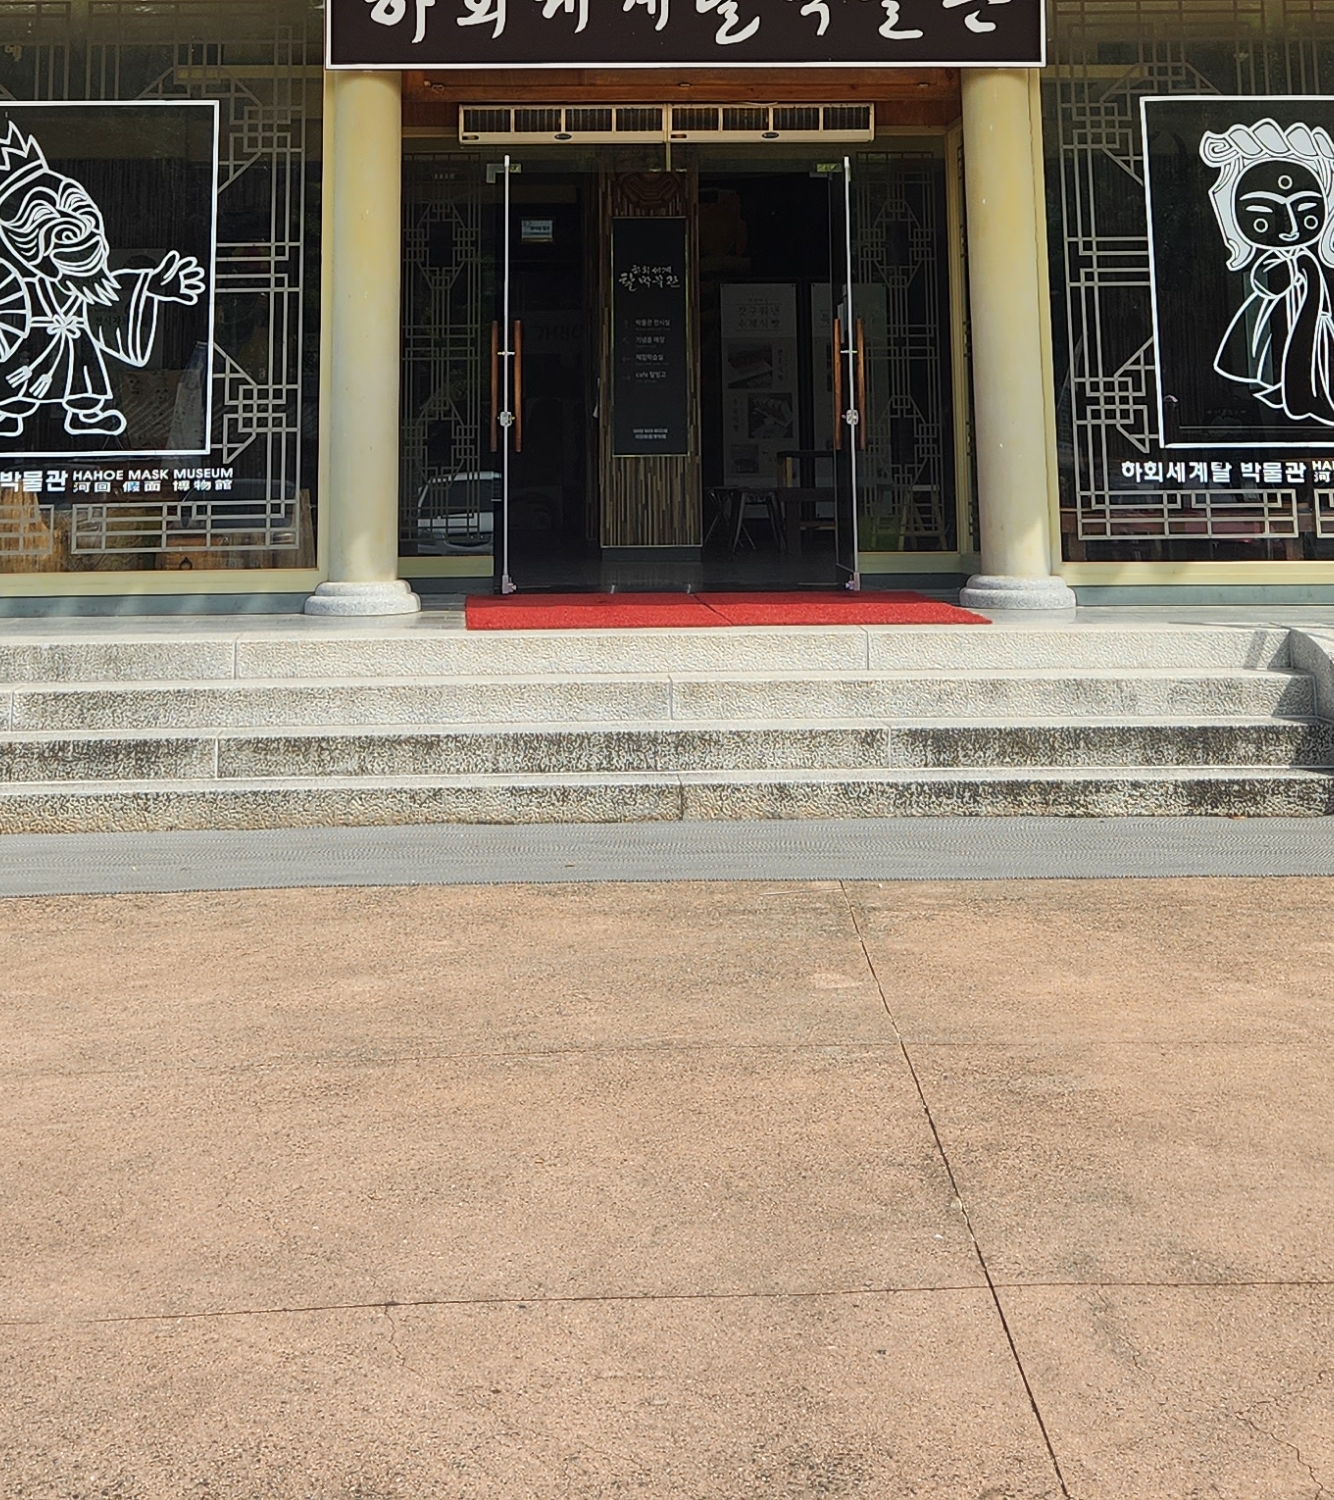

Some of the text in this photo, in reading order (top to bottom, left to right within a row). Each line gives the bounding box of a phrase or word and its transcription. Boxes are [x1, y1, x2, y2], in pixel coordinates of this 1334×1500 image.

[0, 470, 68, 493] 박물관
[72, 468, 234, 481] HAHOE MASK MUSEUM
[1121, 461, 1307, 484] 하회세계탈 박물관
